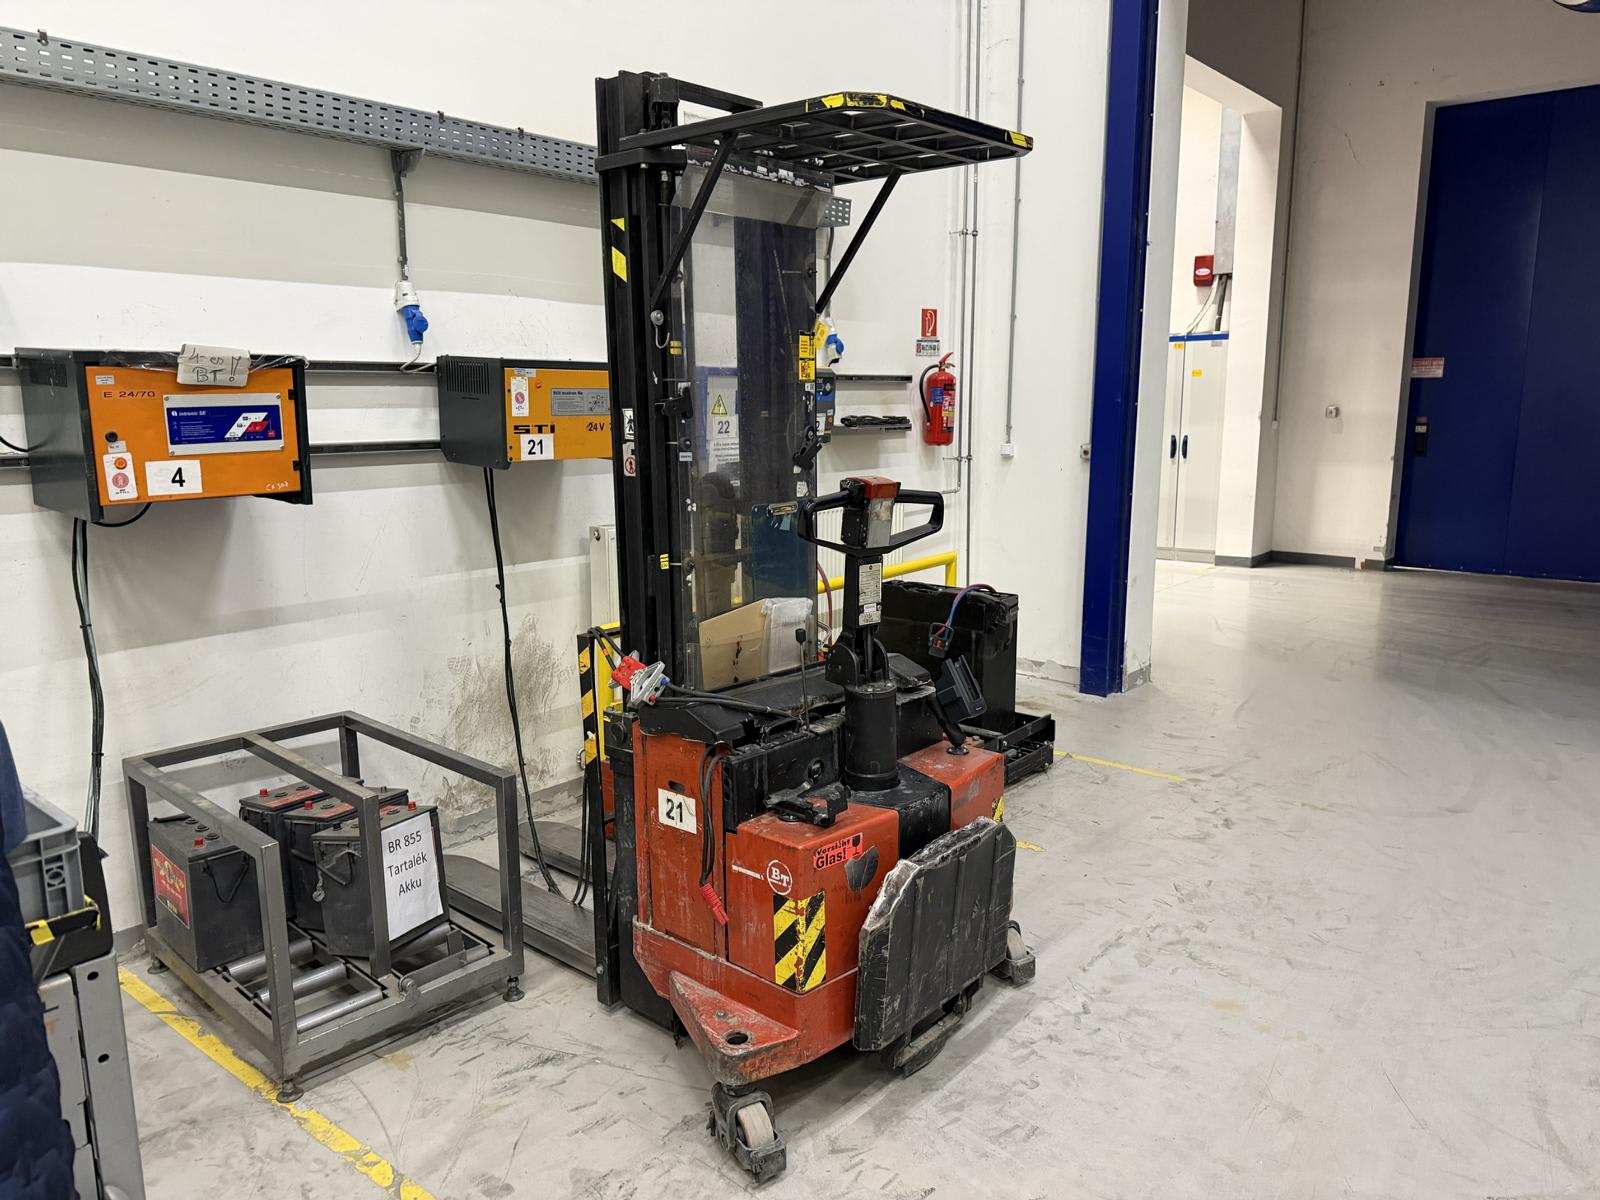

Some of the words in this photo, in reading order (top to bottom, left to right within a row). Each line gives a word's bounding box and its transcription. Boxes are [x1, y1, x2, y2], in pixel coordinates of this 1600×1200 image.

[193, 366, 224, 383] BT
[717, 420, 730, 434] 22
[527, 439, 544, 455] 21
[171, 467, 186, 488] 4
[665, 797, 683, 823] 21
[387, 838, 402, 854] BR
[403, 830, 422, 847] 855
[387, 851, 428, 878] Tartalék
[816, 847, 847, 869] Glas!
[770, 866, 790, 887] BT
[398, 878, 423, 897] Akku
